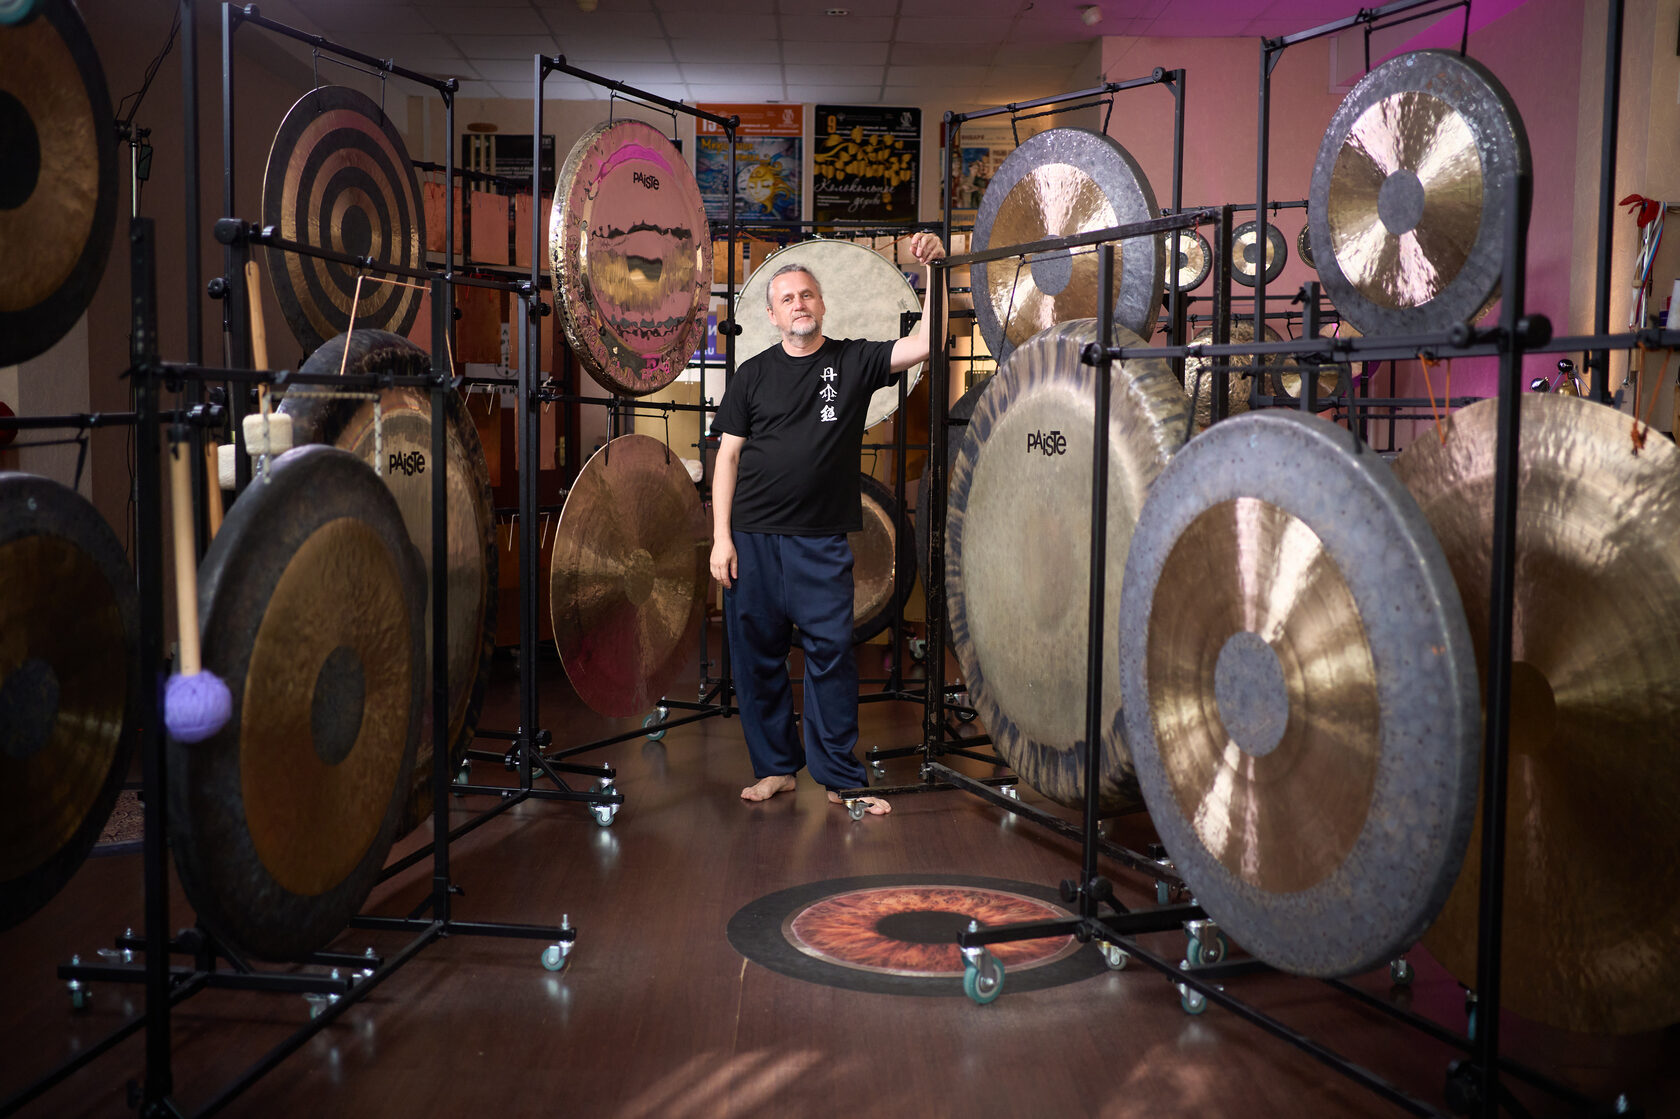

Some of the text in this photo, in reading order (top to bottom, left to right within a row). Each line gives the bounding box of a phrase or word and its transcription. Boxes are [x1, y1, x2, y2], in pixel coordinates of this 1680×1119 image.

[827, 115, 837, 133] 9
[1027, 429, 1067, 457] PAiSTe
[389, 451, 426, 476] PAiSTe
